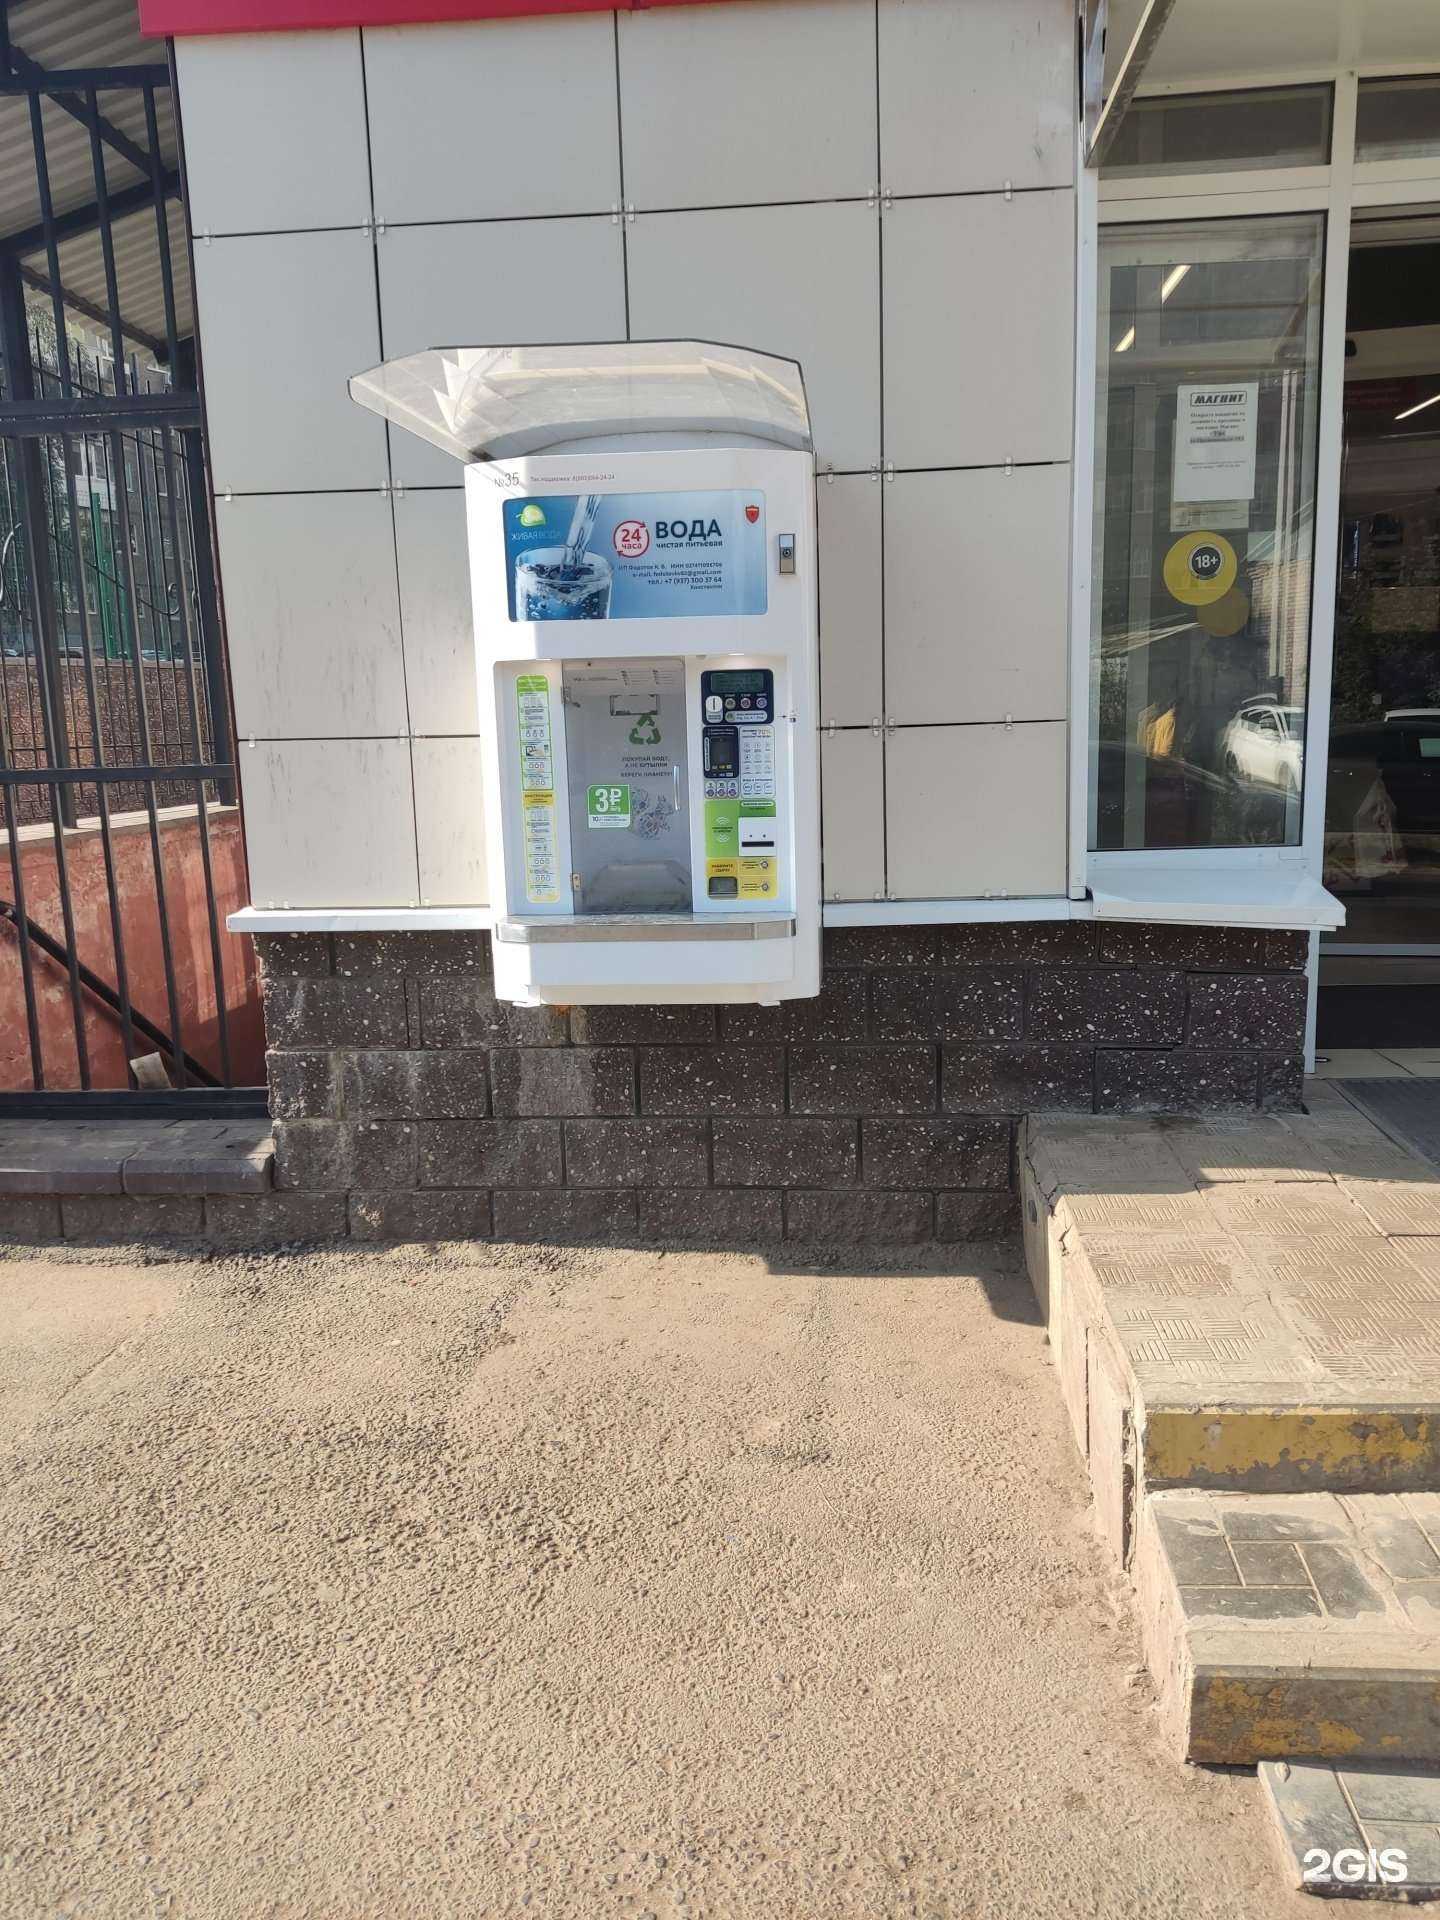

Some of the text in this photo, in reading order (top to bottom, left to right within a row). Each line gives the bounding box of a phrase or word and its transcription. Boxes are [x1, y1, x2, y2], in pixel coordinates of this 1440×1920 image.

[1194, 394, 1244, 404] МАГНИТ
[494, 472, 520, 488] №35
[621, 528, 642, 543] 24
[655, 519, 723, 541] ВОДА
[1195, 555, 1218, 569] 18+
